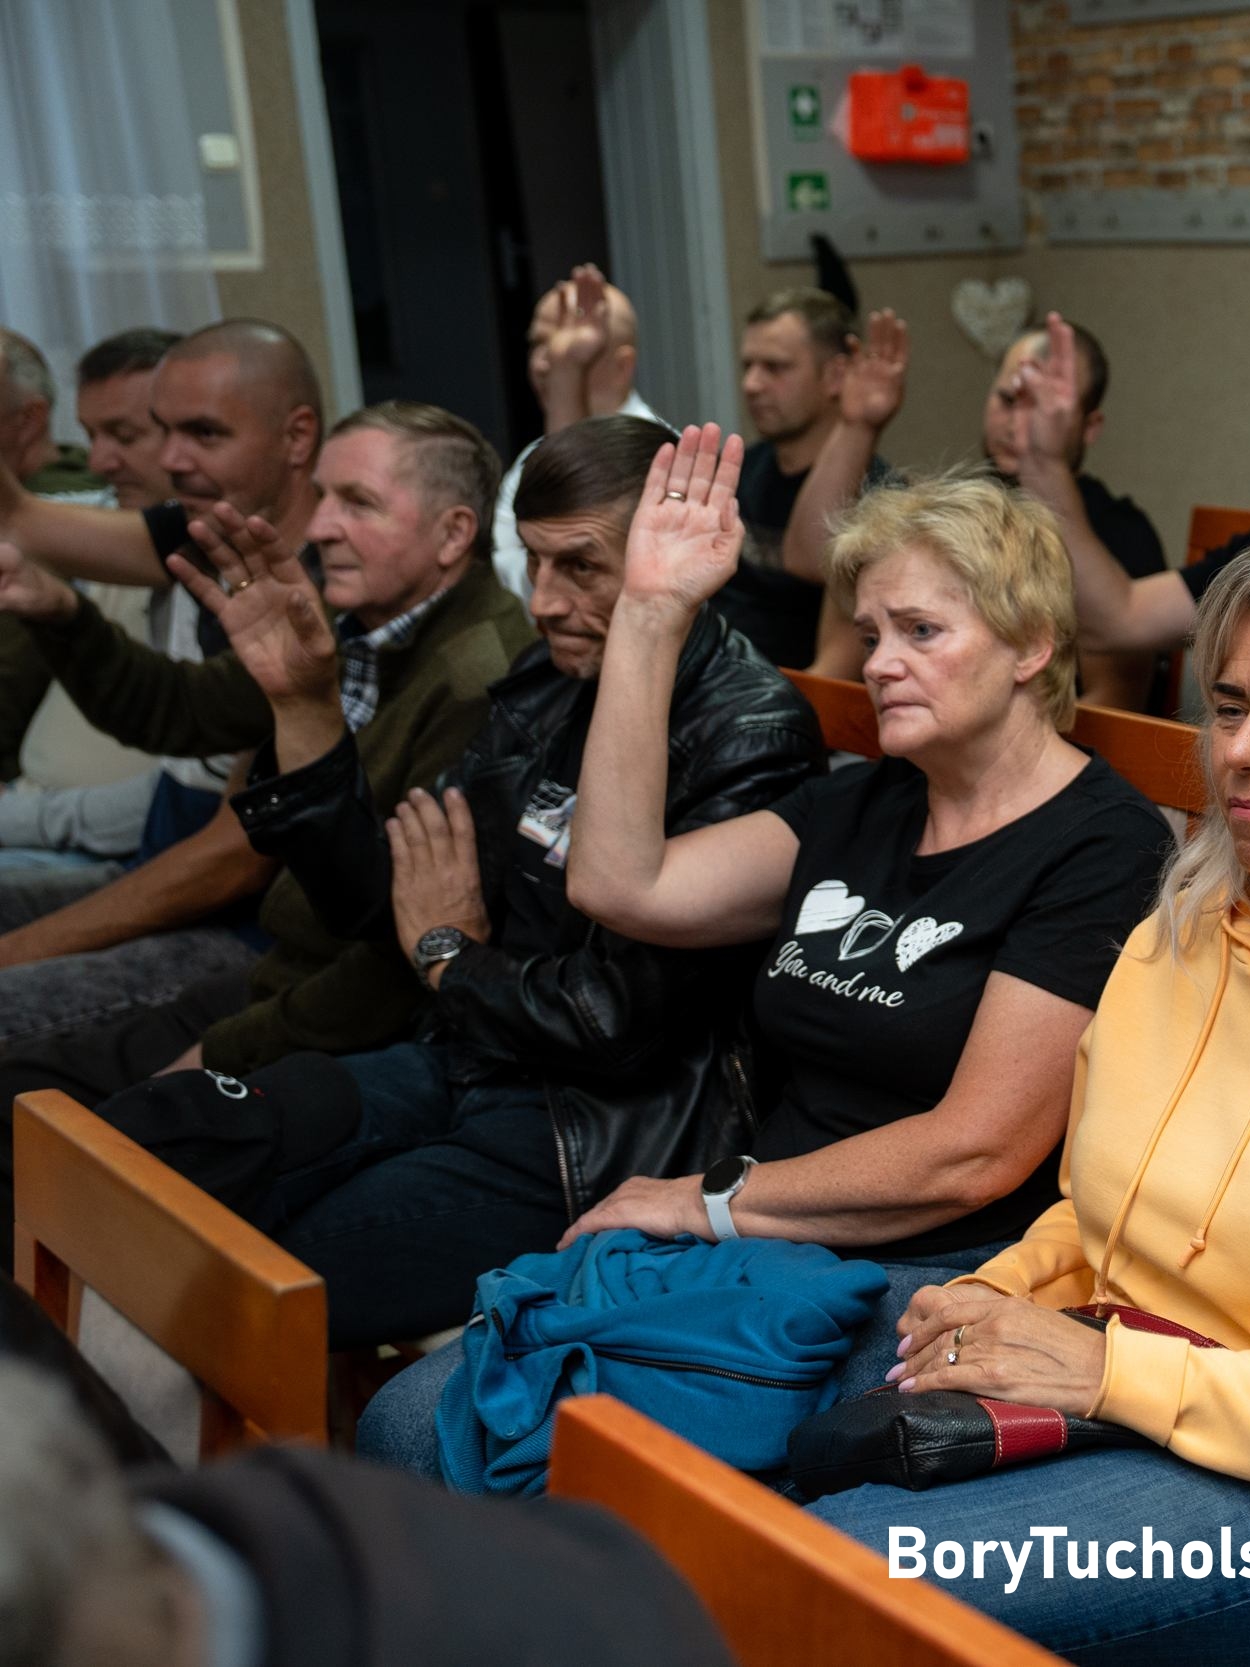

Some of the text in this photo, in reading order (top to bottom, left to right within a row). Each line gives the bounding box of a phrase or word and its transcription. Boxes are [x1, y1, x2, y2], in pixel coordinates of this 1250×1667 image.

[768, 941, 905, 1007] You and me
